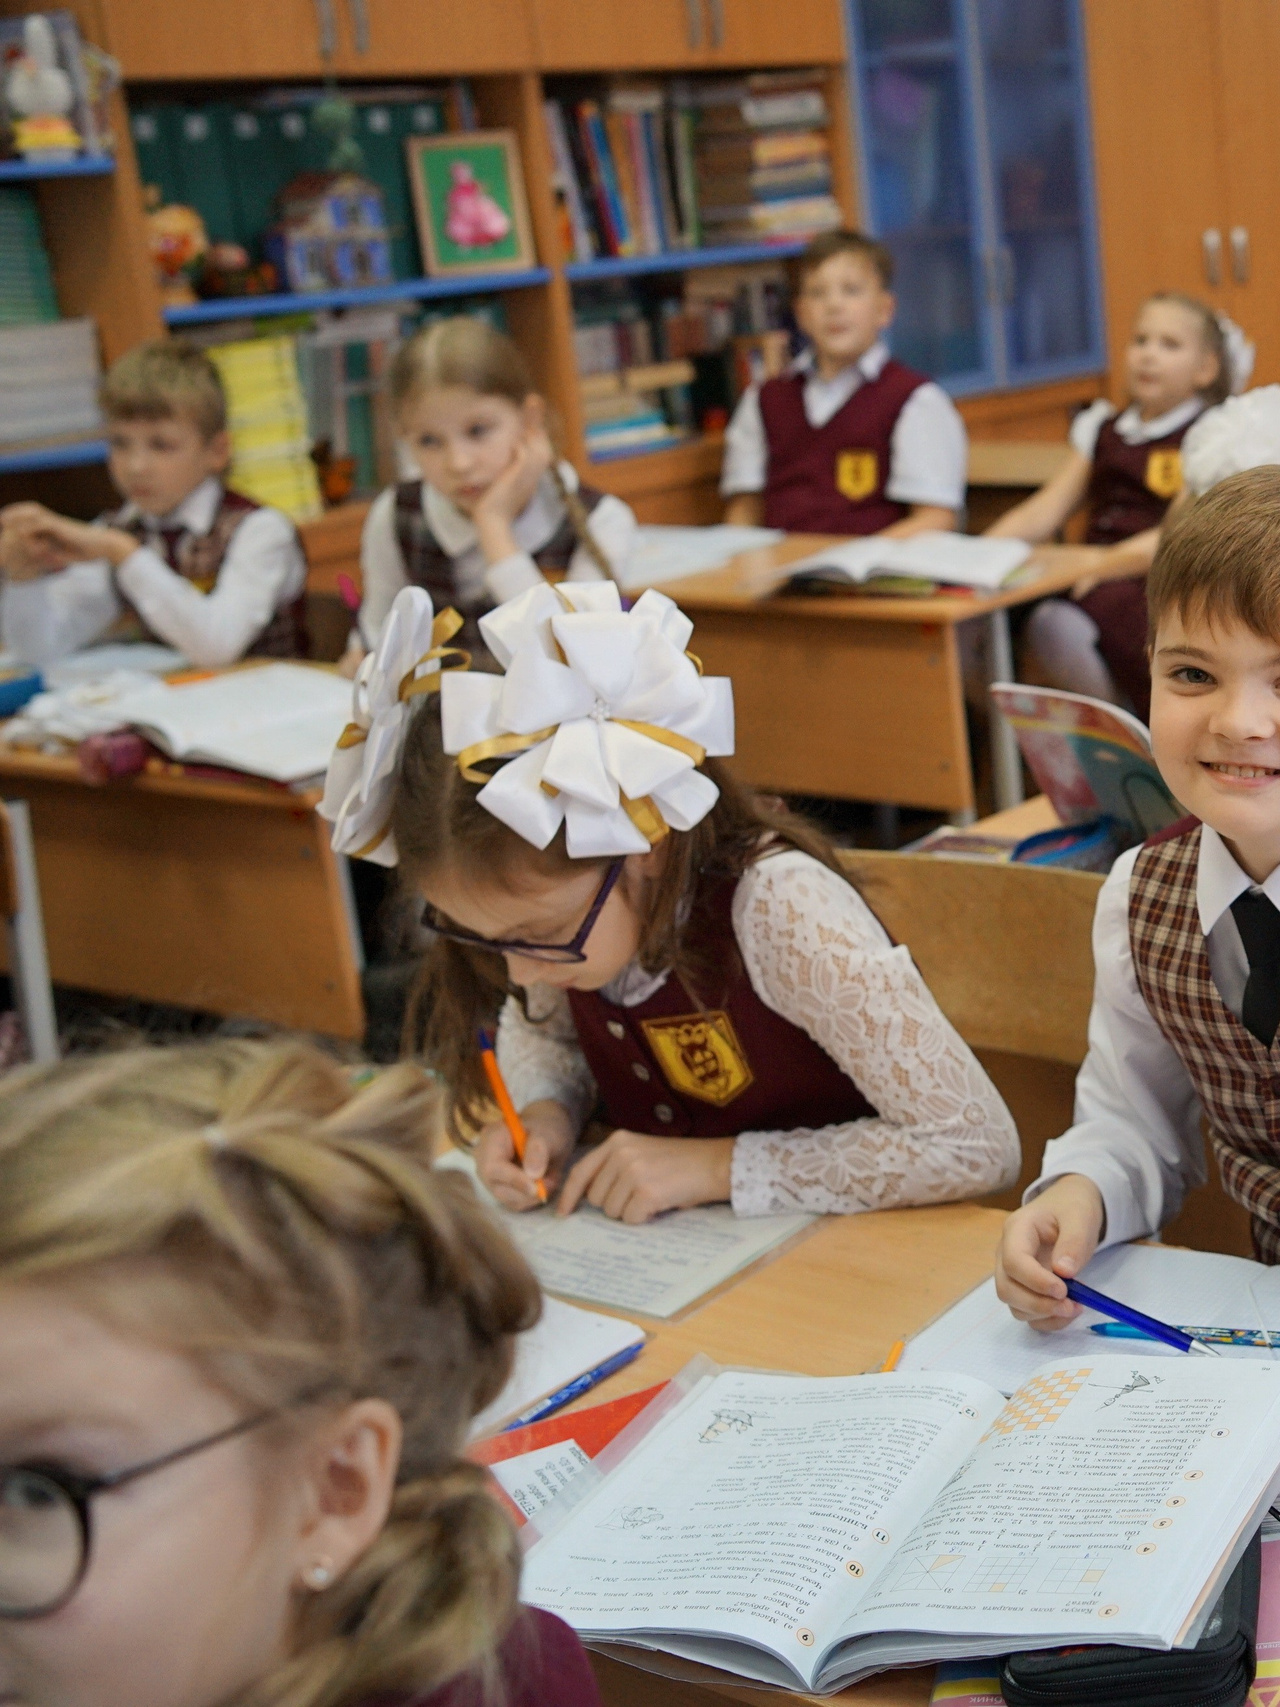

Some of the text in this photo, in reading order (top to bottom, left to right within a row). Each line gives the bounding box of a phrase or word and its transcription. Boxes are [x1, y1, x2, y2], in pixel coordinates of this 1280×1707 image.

[965, 1408, 976, 1417] 12
[839, 1507, 860, 1515] Один
[876, 1532, 885, 1541] 11
[816, 1548, 843, 1562] Найди
[781, 1560, 817, 1573] Седьмая
[799, 1556, 836, 1572] Сколько
[850, 1564, 861, 1577] 10
[764, 1578, 803, 1592] Площадь
[800, 1576, 821, 1589] Чему
[764, 1596, 790, 1608] Масса
[773, 1591, 810, 1606] яблока?
[734, 1602, 798, 1622] этого арбуза?
[863, 1602, 920, 1613] закрашенная
[751, 1612, 778, 1624] Масса
